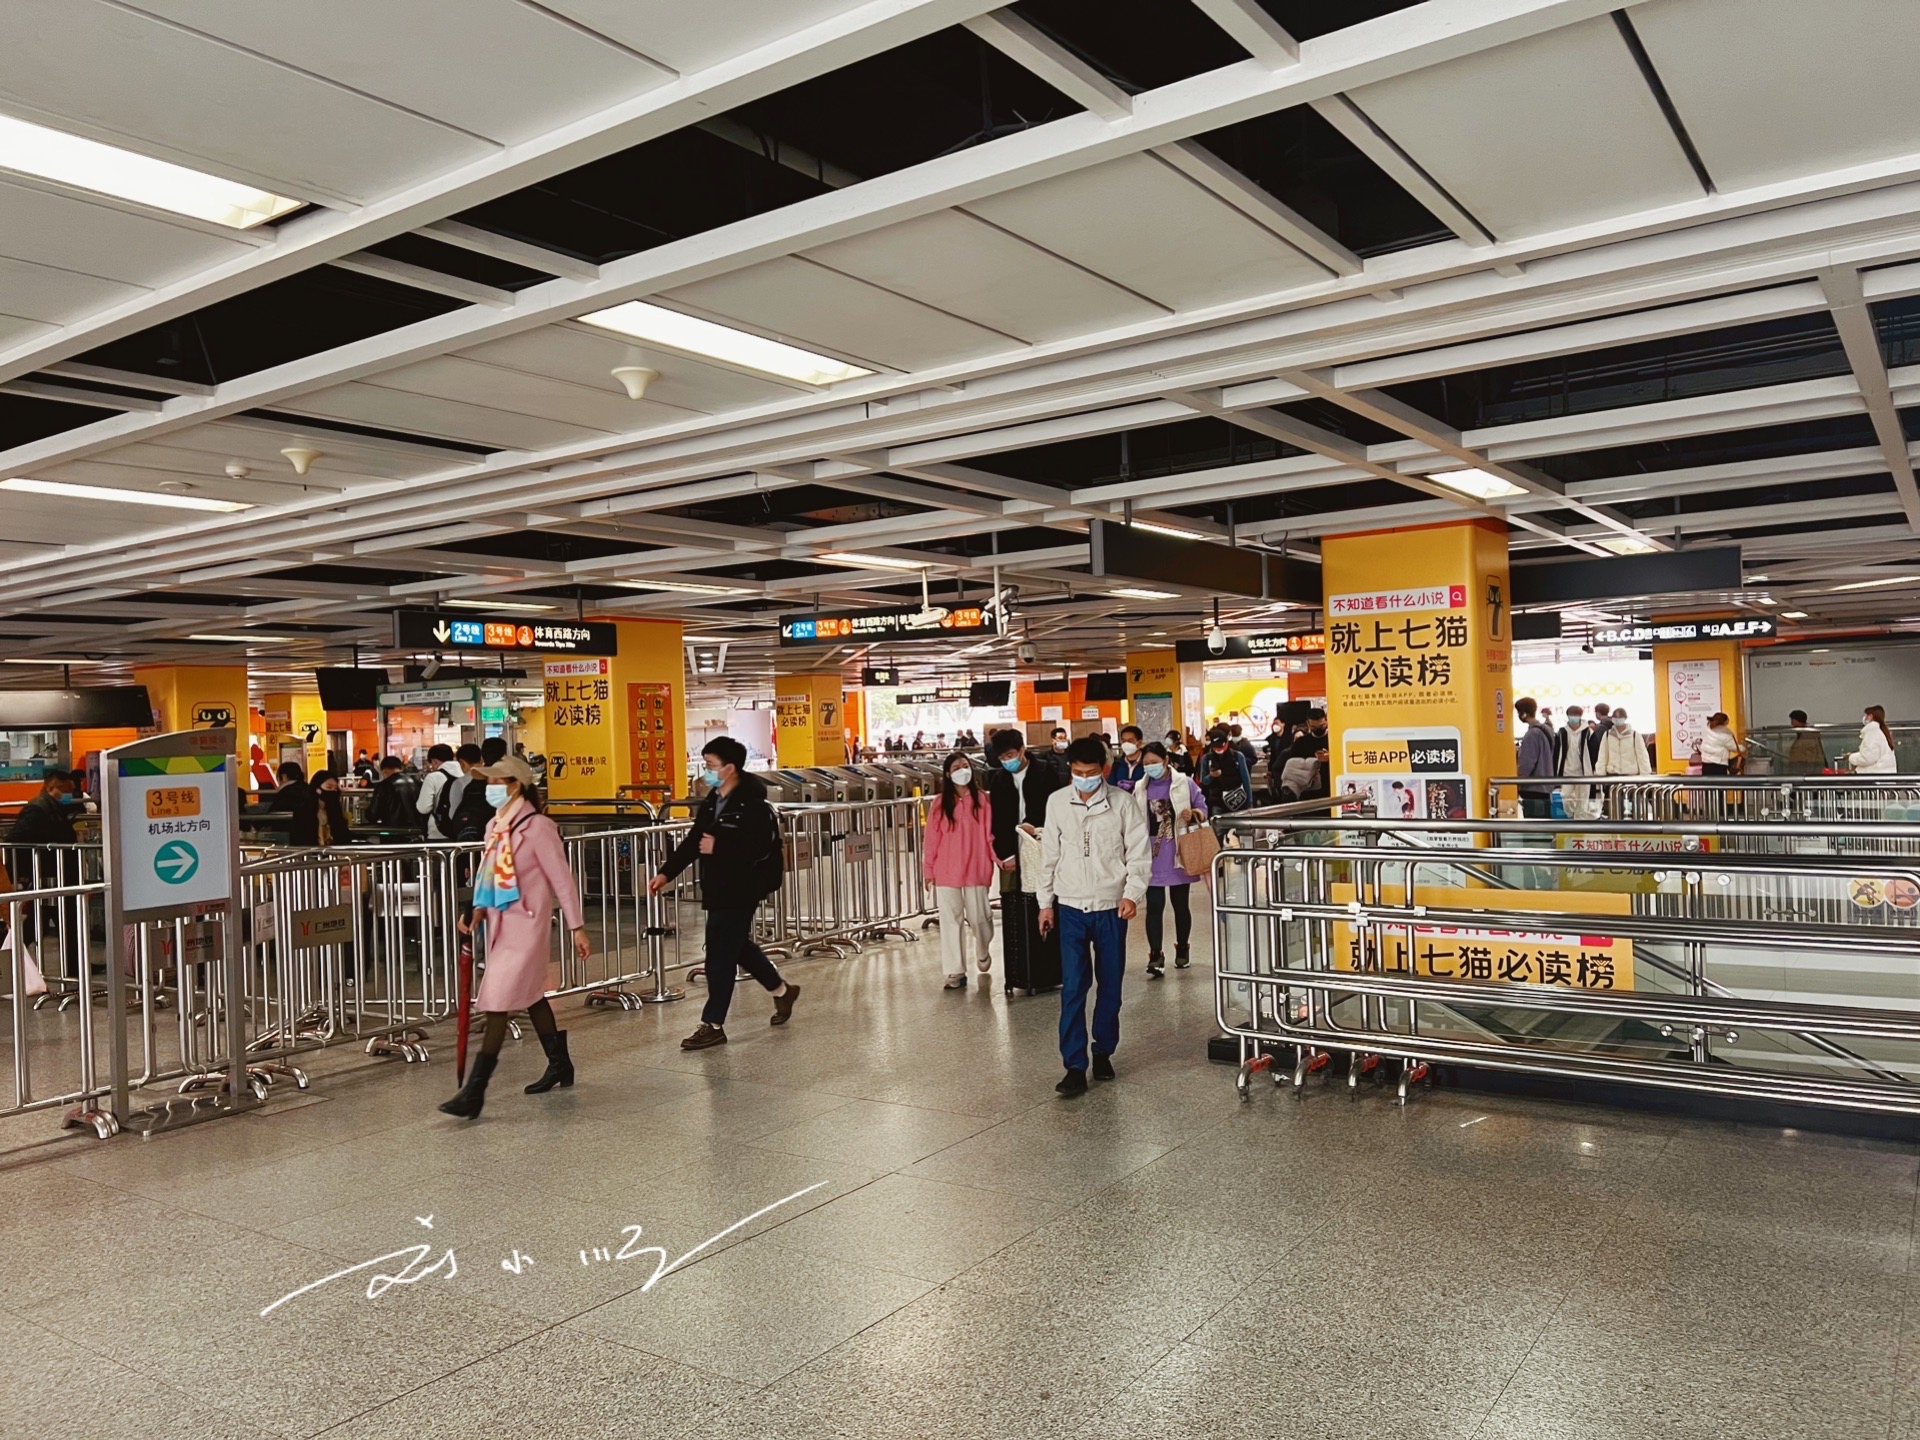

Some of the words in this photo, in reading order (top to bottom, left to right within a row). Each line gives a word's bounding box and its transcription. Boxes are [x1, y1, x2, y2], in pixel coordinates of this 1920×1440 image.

[1333, 591, 1444, 612] 不知道看什么小说
[454, 623, 480, 635] 2号线
[487, 625, 513, 637] 3号线
[534, 625, 591, 641] 体育西路方向
[1330, 616, 1467, 654] 就上七猫
[1248, 637, 1287, 649] 机场北方向
[546, 663, 598, 674] 不知道看什么小说
[1348, 653, 1451, 689] 必读榜
[546, 680, 608, 702] 就上七猫
[554, 704, 601, 726] 必读榜
[1349, 750, 1408, 765] 七猫APP
[1411, 749, 1456, 765] 必读榜
[580, 766, 596, 776] APP
[152, 790, 195, 806] 3号线
[148, 820, 211, 835] 机场北方向
[1572, 840, 1682, 852] 不知道看什么小说
[1350, 938, 1615, 988] 就上七猫必读榜
